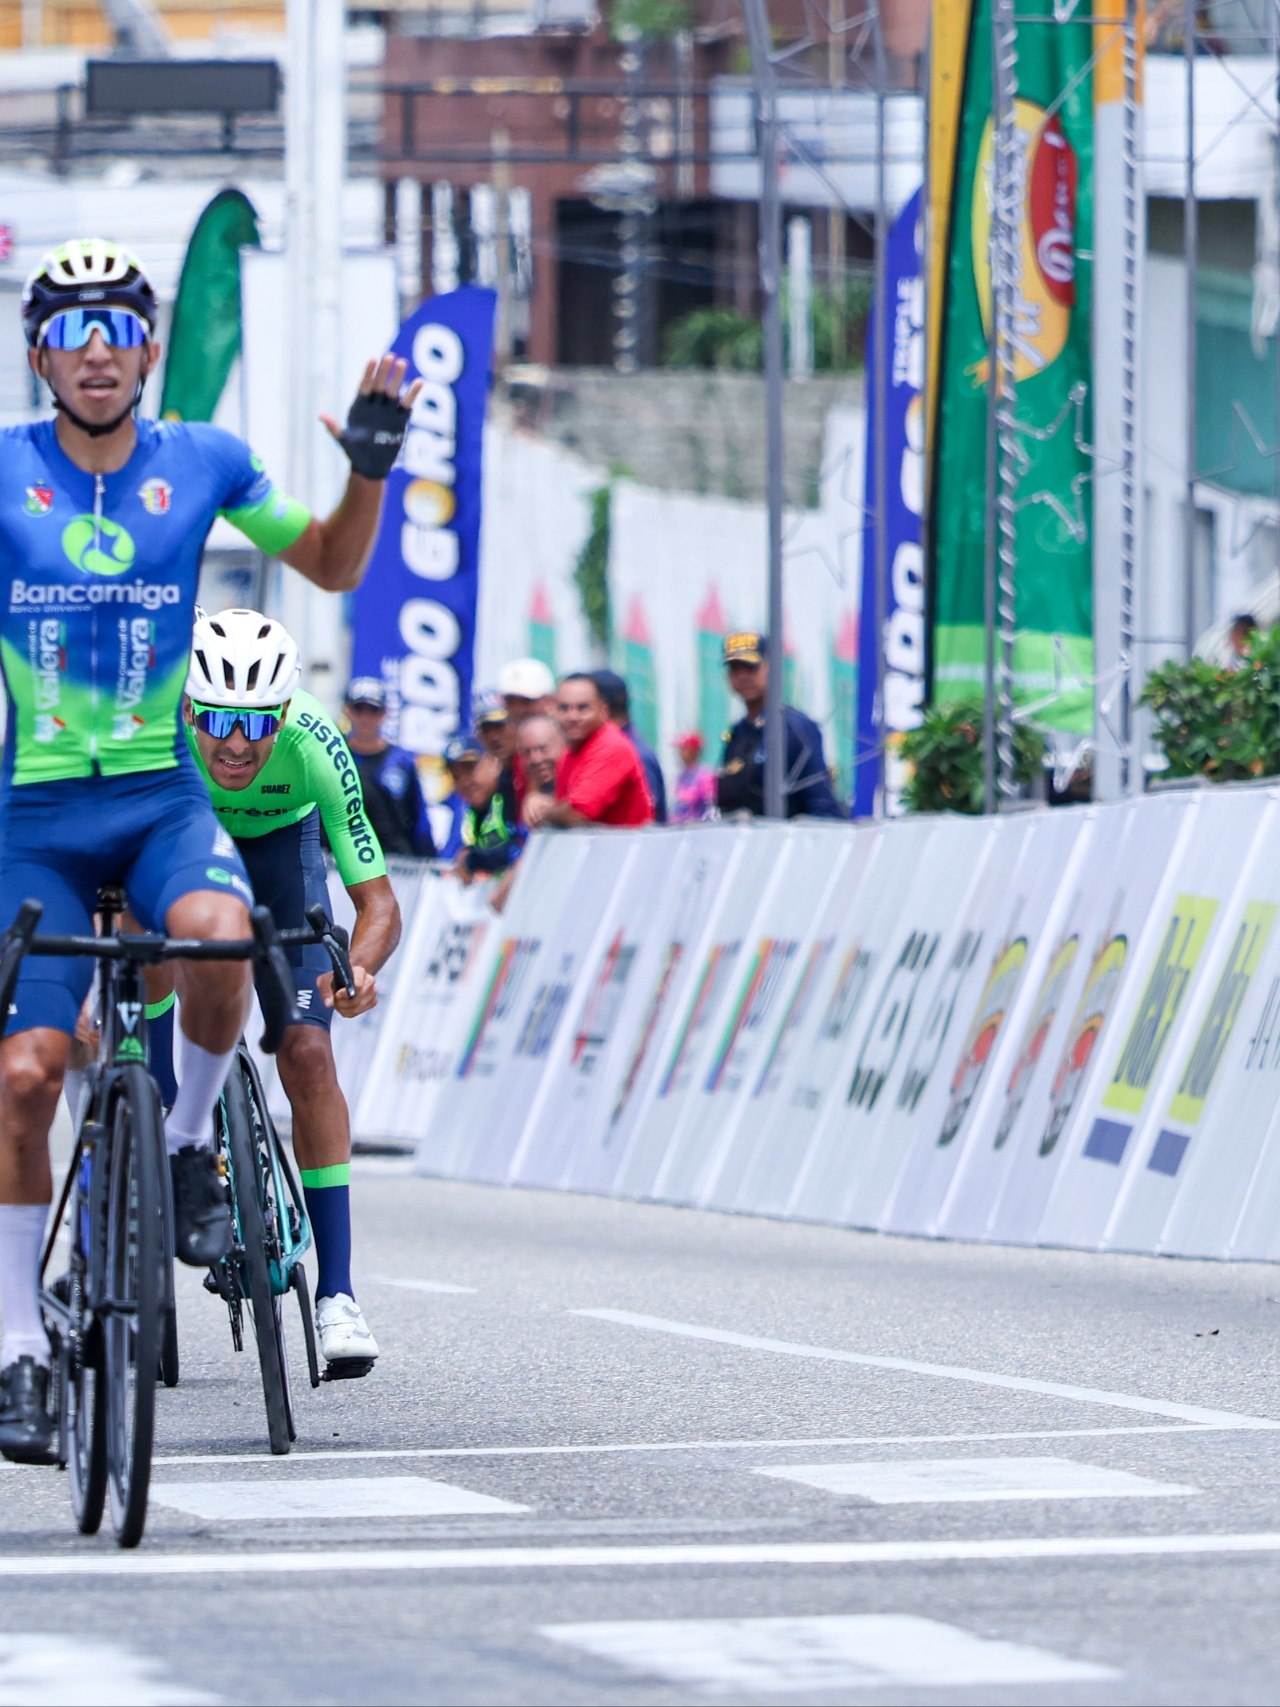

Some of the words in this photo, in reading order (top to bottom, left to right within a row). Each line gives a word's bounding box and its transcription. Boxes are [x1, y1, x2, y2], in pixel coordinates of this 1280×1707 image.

[401, 322, 464, 583] GORDO
[10, 578, 180, 610] Bancamiga
[35, 619, 60, 710] Valera
[115, 617, 150, 710] Valera
[261, 784, 290, 794] SUAREZ
[296, 711, 375, 863] sistecredito
